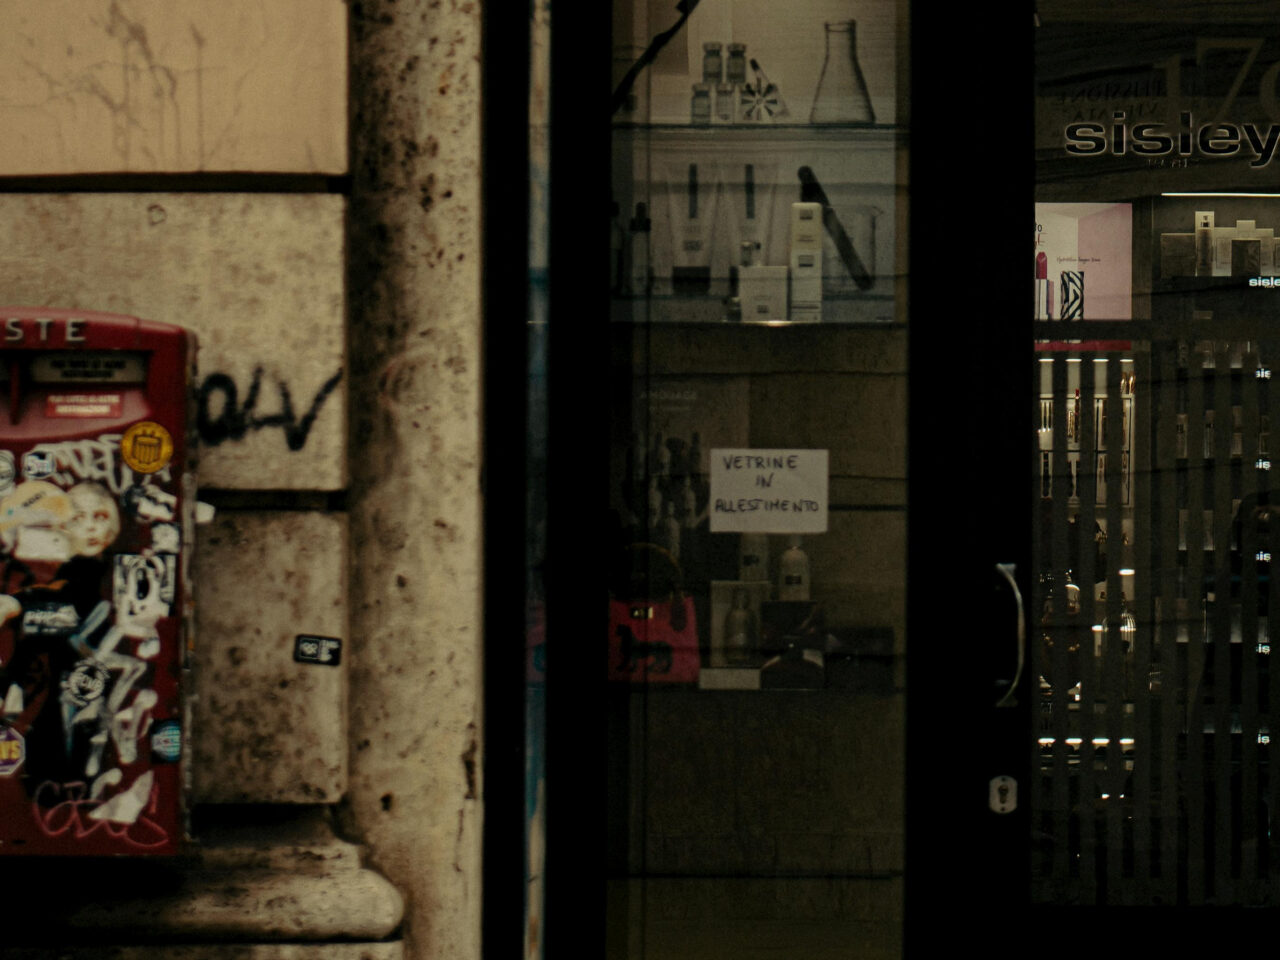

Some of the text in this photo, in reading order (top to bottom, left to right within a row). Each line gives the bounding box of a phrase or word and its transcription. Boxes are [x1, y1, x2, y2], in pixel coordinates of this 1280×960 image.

[722, 455, 799, 470] VETRINE
[755, 472, 775, 488] IN
[715, 498, 819, 512] ALLESTIMENTO
